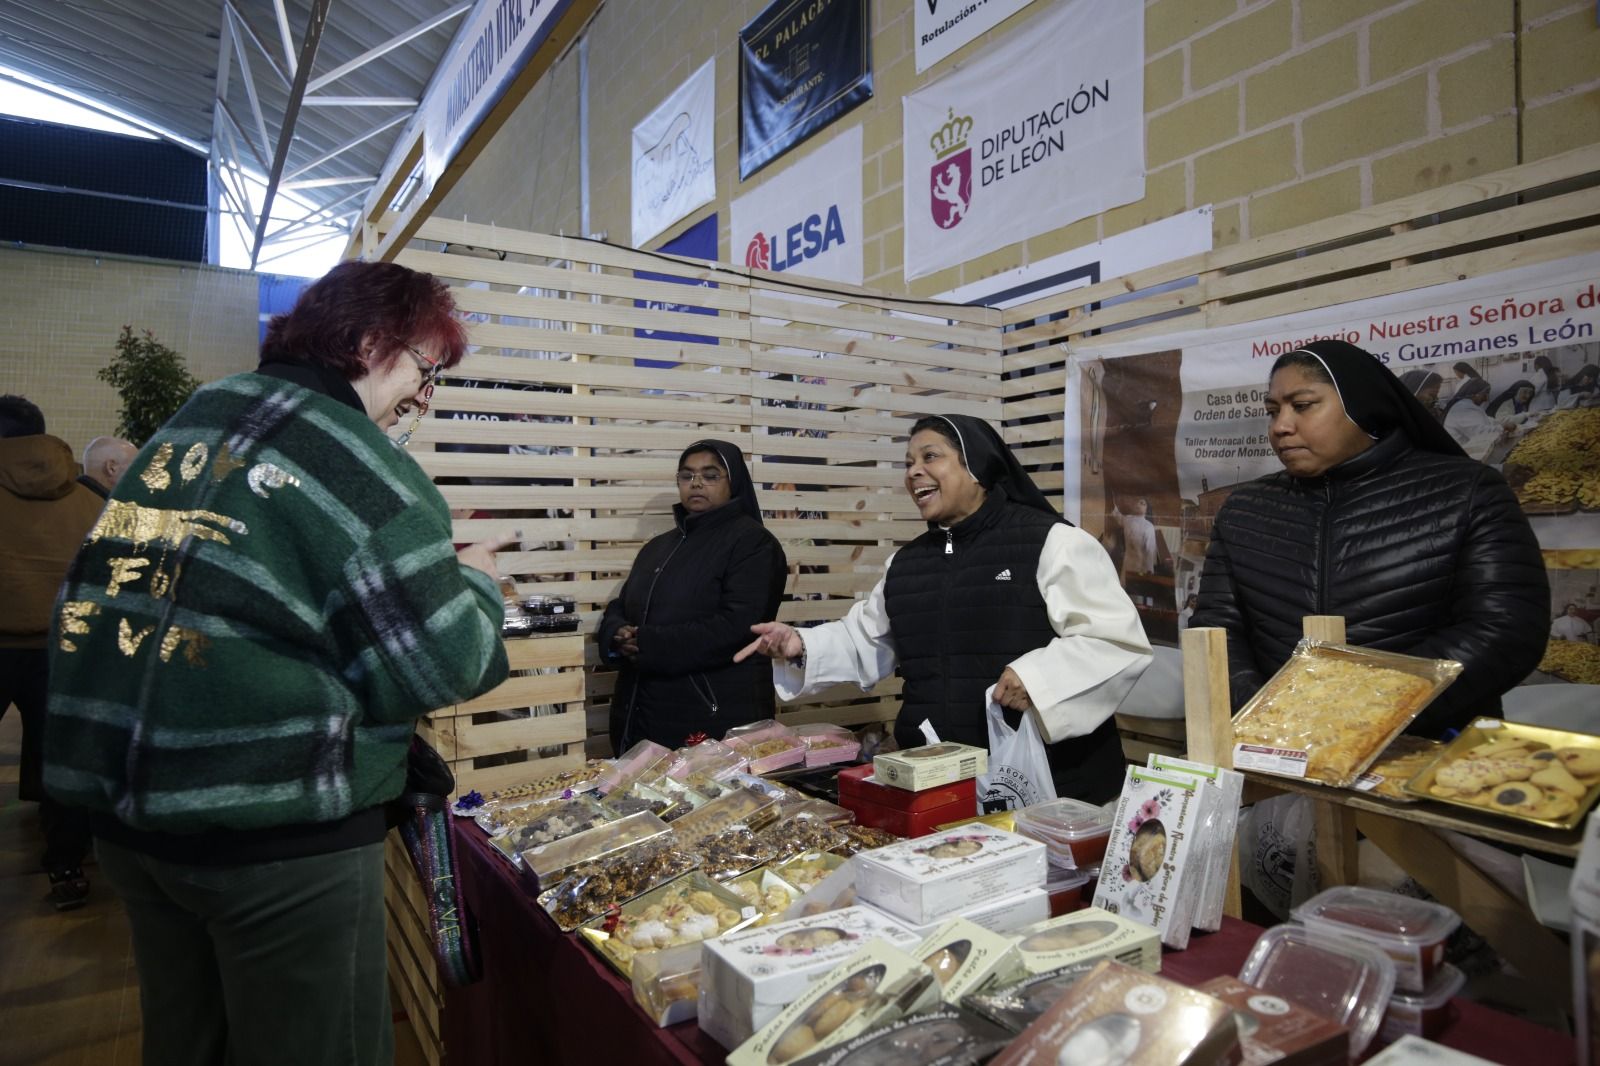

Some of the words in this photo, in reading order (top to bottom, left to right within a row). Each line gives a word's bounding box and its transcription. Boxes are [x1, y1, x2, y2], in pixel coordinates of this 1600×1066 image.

[920, 2, 977, 46] Rotulación
[445, 19, 494, 137] MONASTERIO
[981, 79, 1109, 160] DIPUTACIÓN
[981, 158, 1005, 187] DE
[1011, 129, 1064, 174] LEÓN
[770, 204, 846, 272] LESA
[1369, 317, 1459, 341] Nuestra
[1469, 297, 1565, 327] Señora
[1576, 284, 1600, 309] d
[1398, 332, 1518, 361] Guzmanes
[1528, 317, 1593, 345] León
[1193, 409, 1226, 421] Orden
[1228, 407, 1242, 419] de
[1244, 405, 1265, 418] San
[1207, 393, 1233, 406] Casa
[1235, 391, 1249, 403] de
[1184, 437, 1207, 447] Taller
[1208, 436, 1245, 446] Monacal
[1246, 434, 1257, 444] de
[1194, 448, 1236, 459] Obrador
